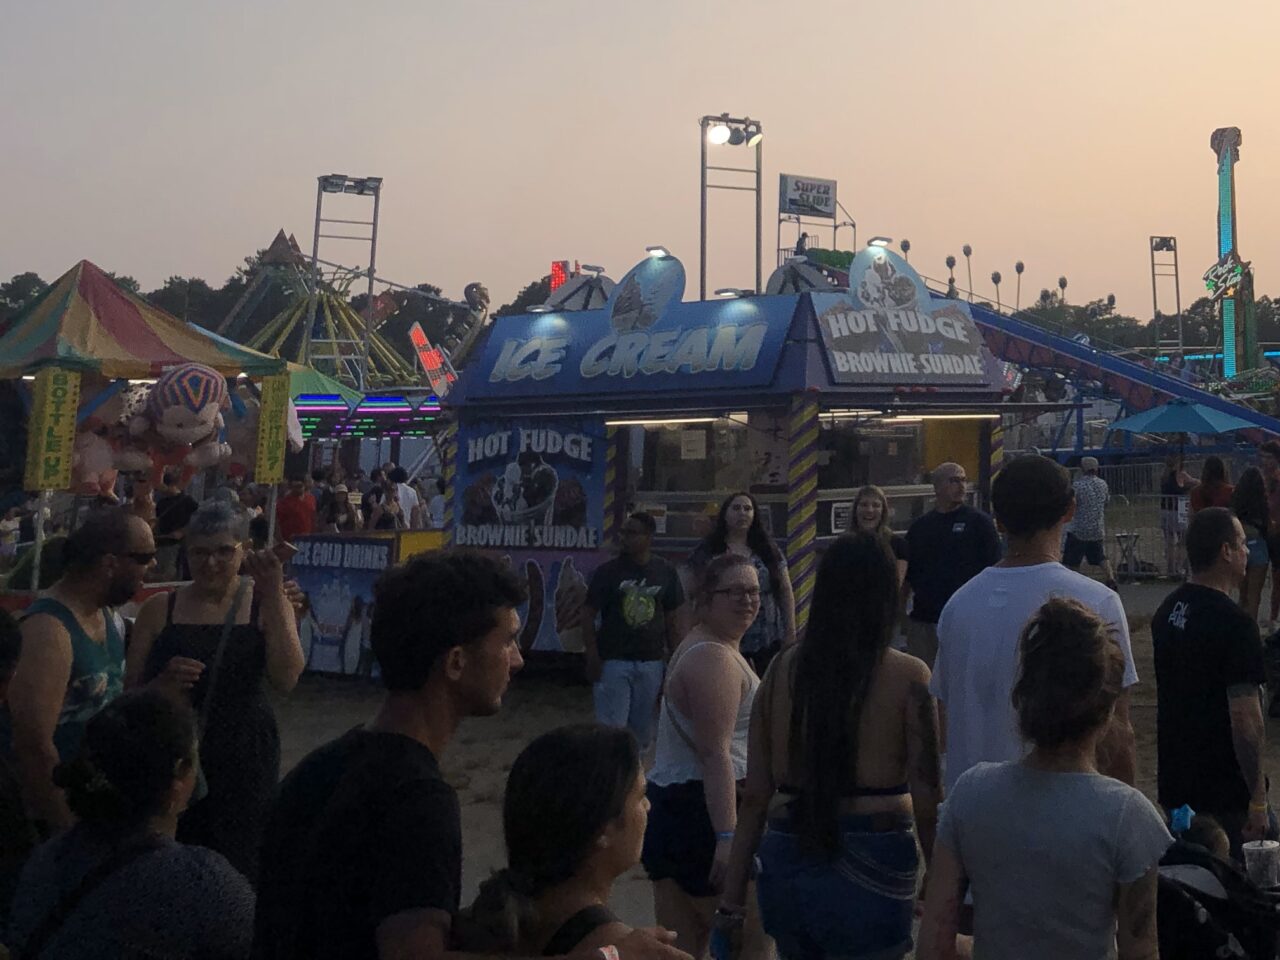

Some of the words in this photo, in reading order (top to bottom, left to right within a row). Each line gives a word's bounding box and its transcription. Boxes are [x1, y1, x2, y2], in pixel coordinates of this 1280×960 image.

[793, 180, 830, 195] SUPER
[799, 193, 832, 207] SLIDE
[1211, 272, 1242, 299] Star
[827, 310, 879, 338] HOT
[886, 309, 970, 343] FUDGE
[491, 336, 569, 382] ICE
[580, 323, 768, 379] CREAM
[833, 351, 918, 374] BROWNIE
[918, 353, 985, 376] SUNDAE
[45, 373, 68, 452] BOTTLE
[468, 431, 512, 463] HOT
[519, 428, 593, 462] FUDGE
[455, 523, 530, 547] BROWNIE
[532, 525, 598, 549] SUNDAE
[292, 542, 311, 566] ICE
[312, 542, 343, 567] COLD
[344, 543, 389, 570] DRINKS
